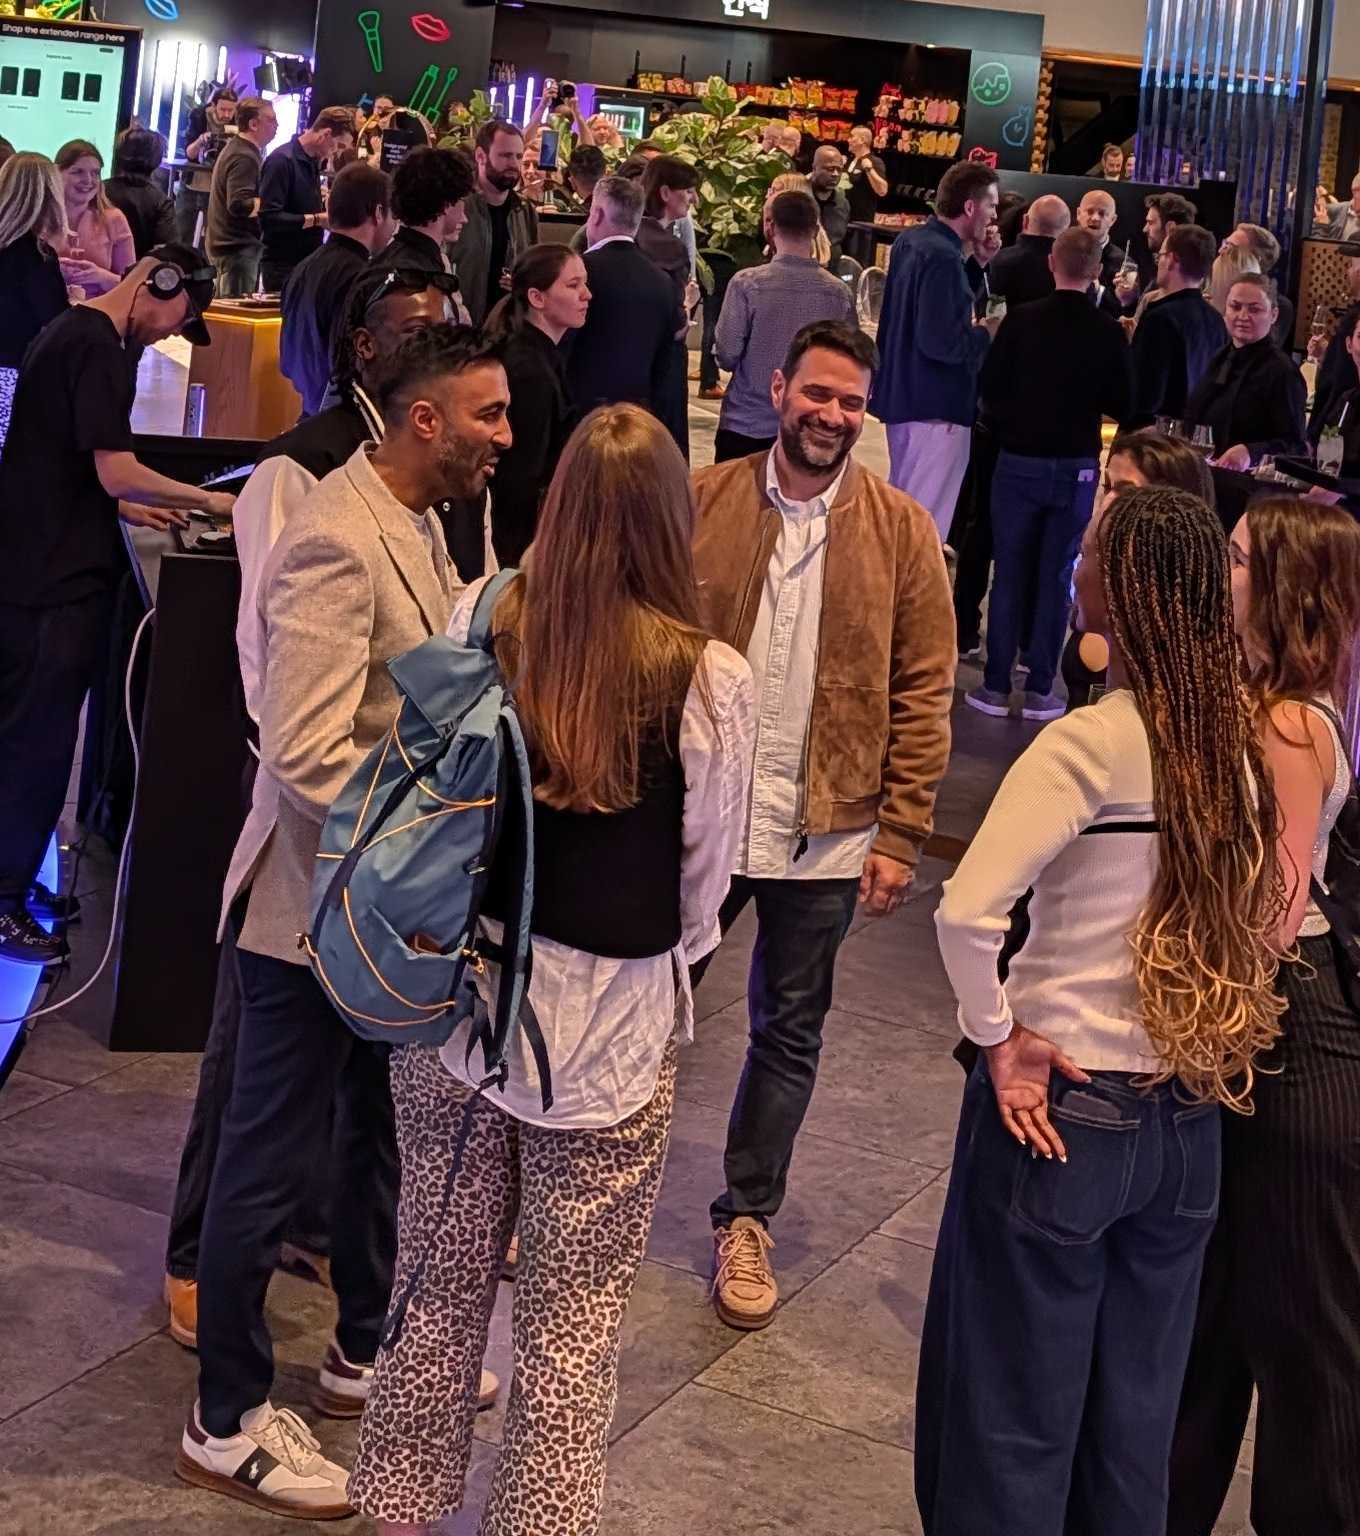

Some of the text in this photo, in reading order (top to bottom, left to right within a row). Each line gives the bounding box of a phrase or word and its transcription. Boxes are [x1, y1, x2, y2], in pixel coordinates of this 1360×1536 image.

[1, 23, 126, 43] Shop the extended range here
